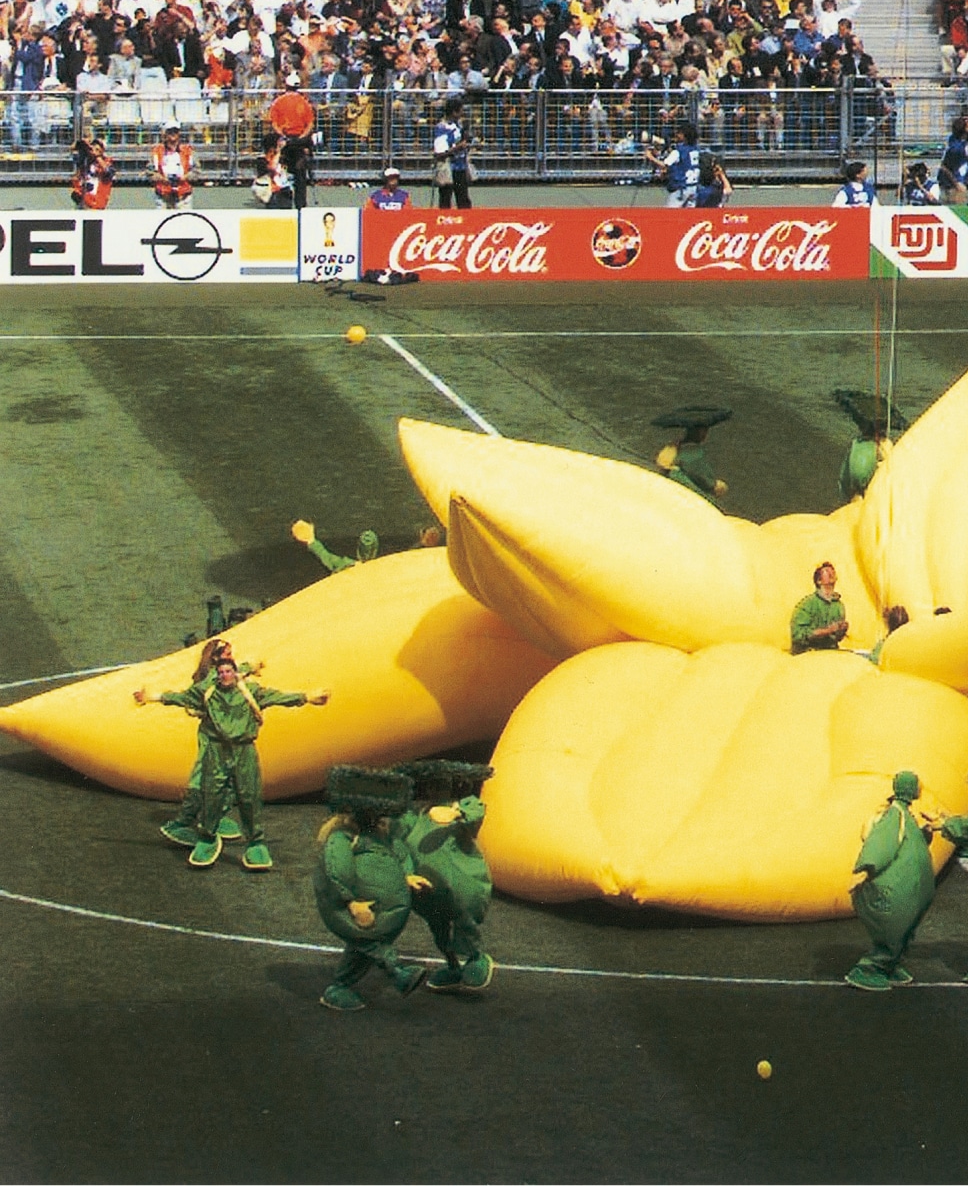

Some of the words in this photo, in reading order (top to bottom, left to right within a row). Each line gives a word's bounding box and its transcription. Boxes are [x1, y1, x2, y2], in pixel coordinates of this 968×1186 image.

[0, 219, 144, 276] EL
[304, 254, 355, 264] WORLD
[315, 265, 343, 276] CUP
[388, 221, 553, 273] Coca-Cola
[675, 220, 837, 272] Coca-Cola
